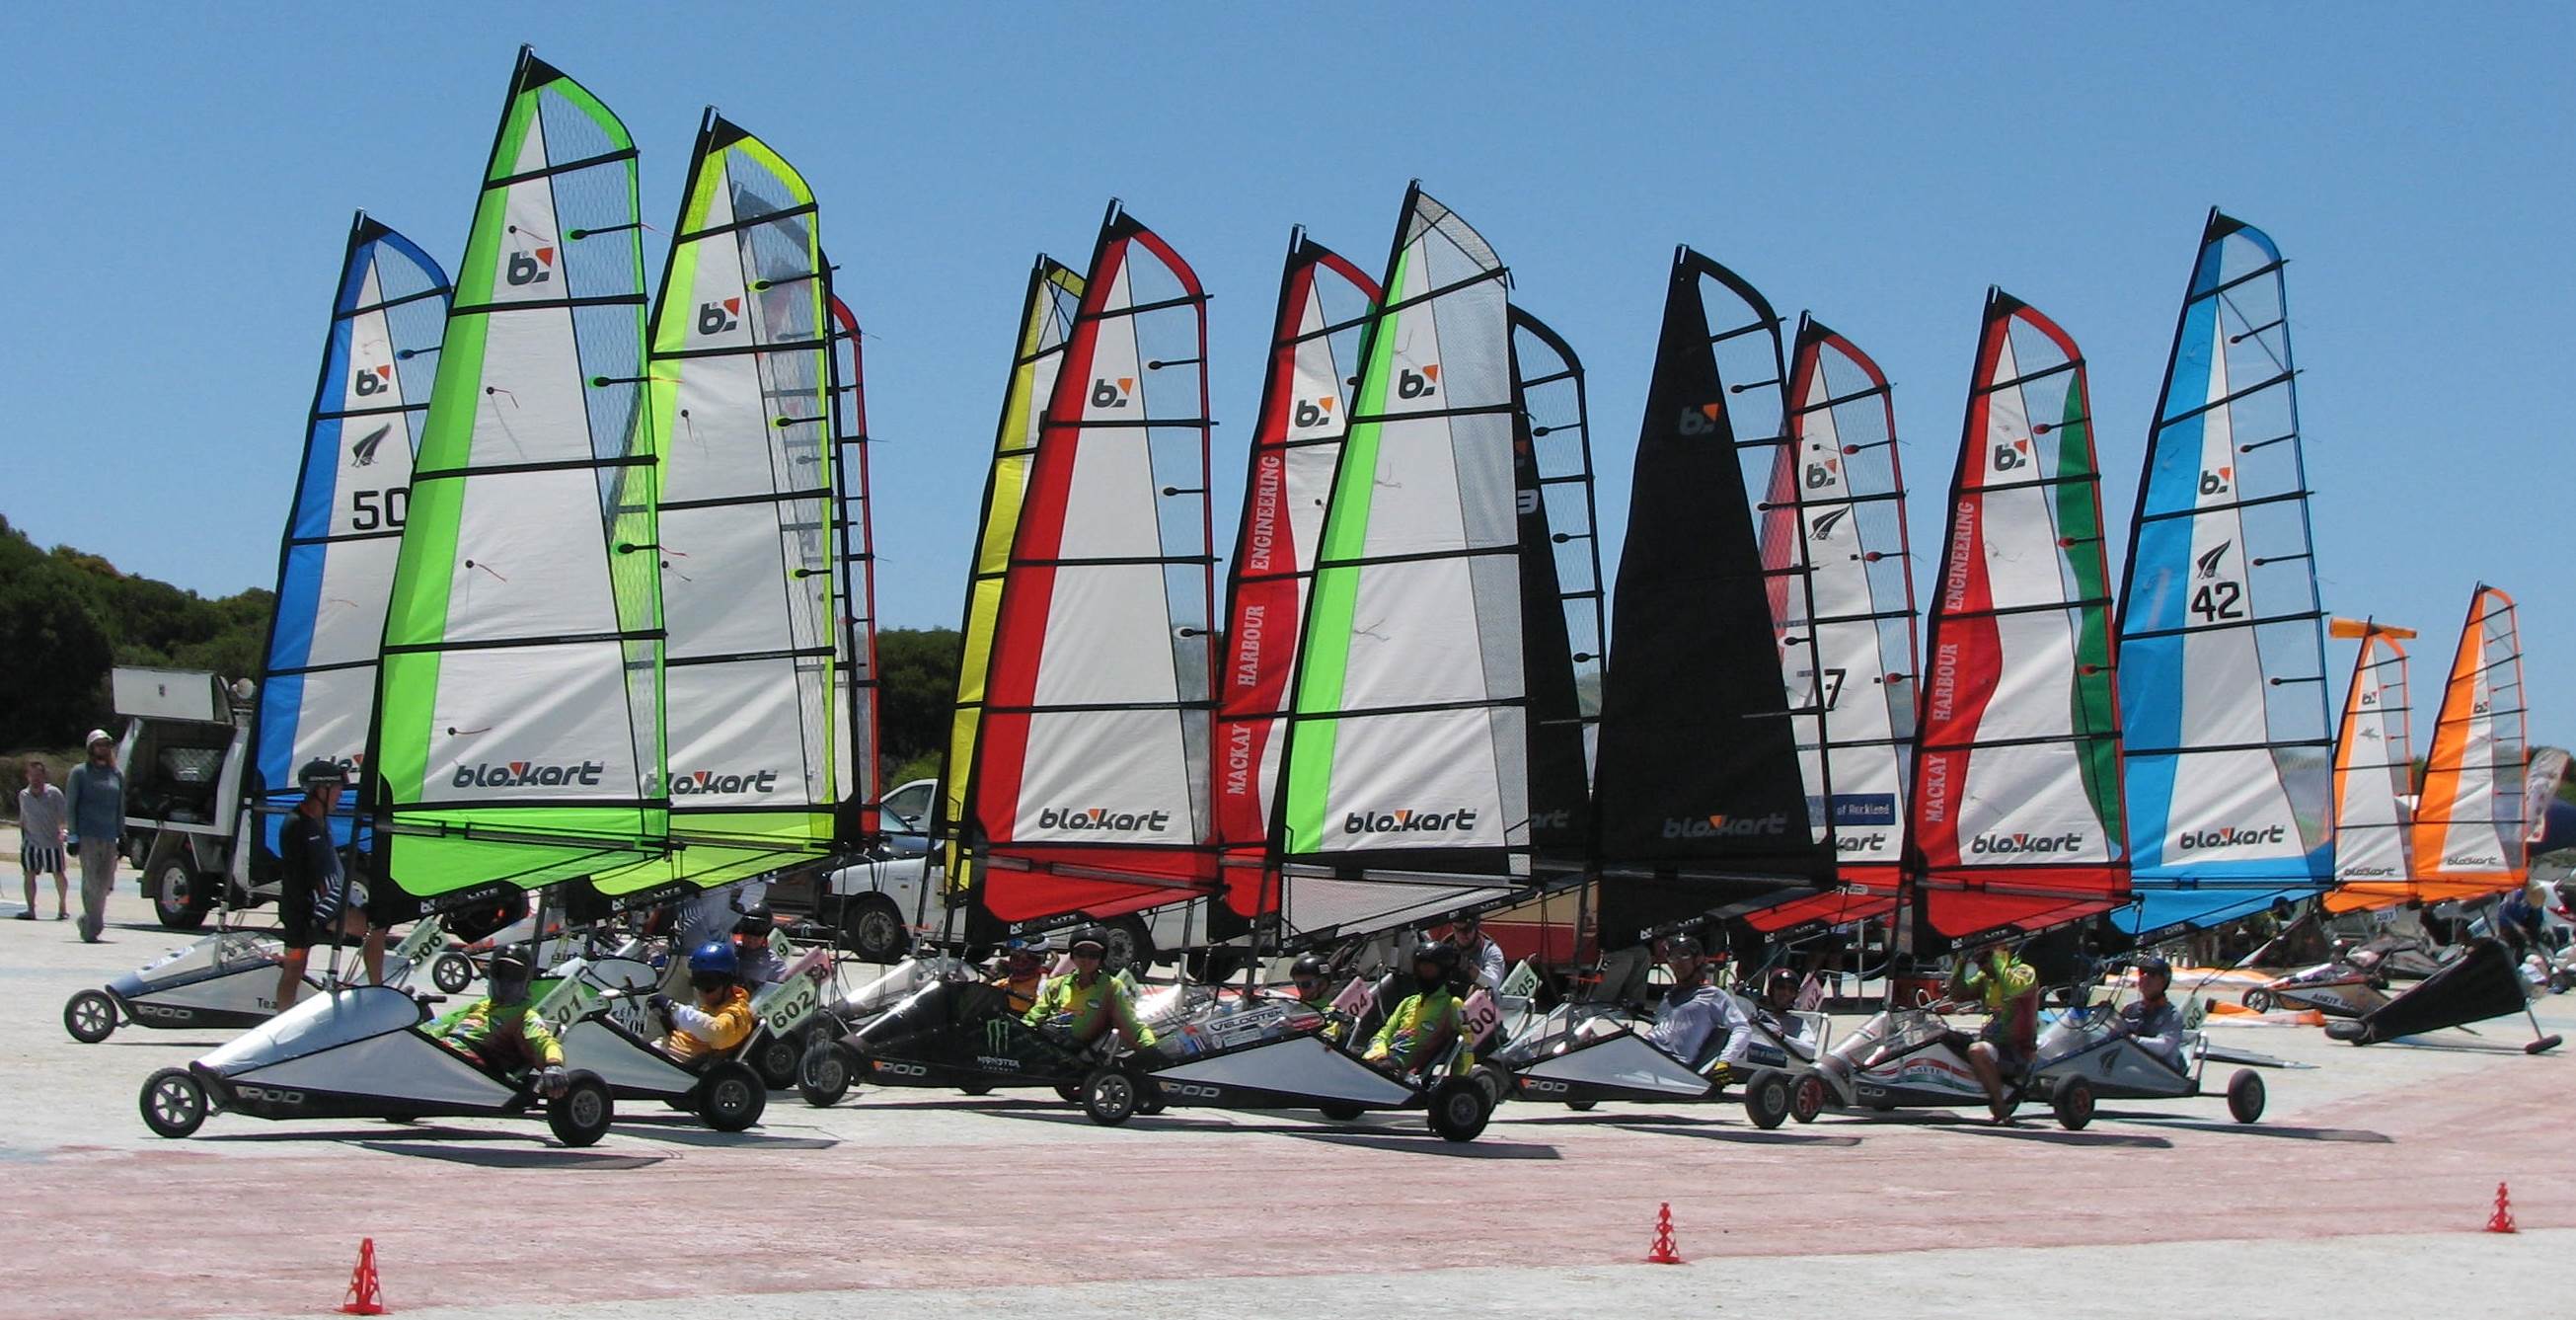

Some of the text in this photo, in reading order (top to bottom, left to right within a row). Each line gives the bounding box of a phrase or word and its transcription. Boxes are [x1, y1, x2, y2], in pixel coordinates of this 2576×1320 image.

[2191, 581, 2244, 623] 42
[1227, 454, 1281, 796] MACKAY HARBOUR ENGINEERING
[1926, 501, 1975, 822] MACKAY HARBOUR ENGINEERING
[1837, 805, 1846, 815] of
[467, 888, 497, 899] LITE
[1049, 913, 1077, 924] LITE
[1678, 916, 1705, 928] LITE
[1513, 974, 1535, 997] 05
[256, 997, 278, 1009] Tea
[549, 994, 582, 1024] 01
[772, 990, 814, 1029] 602
[880, 1061, 927, 1076] POD
[1166, 1082, 1221, 1098] POD
[1529, 1079, 1568, 1093] POD
[245, 1087, 305, 1104] POD
